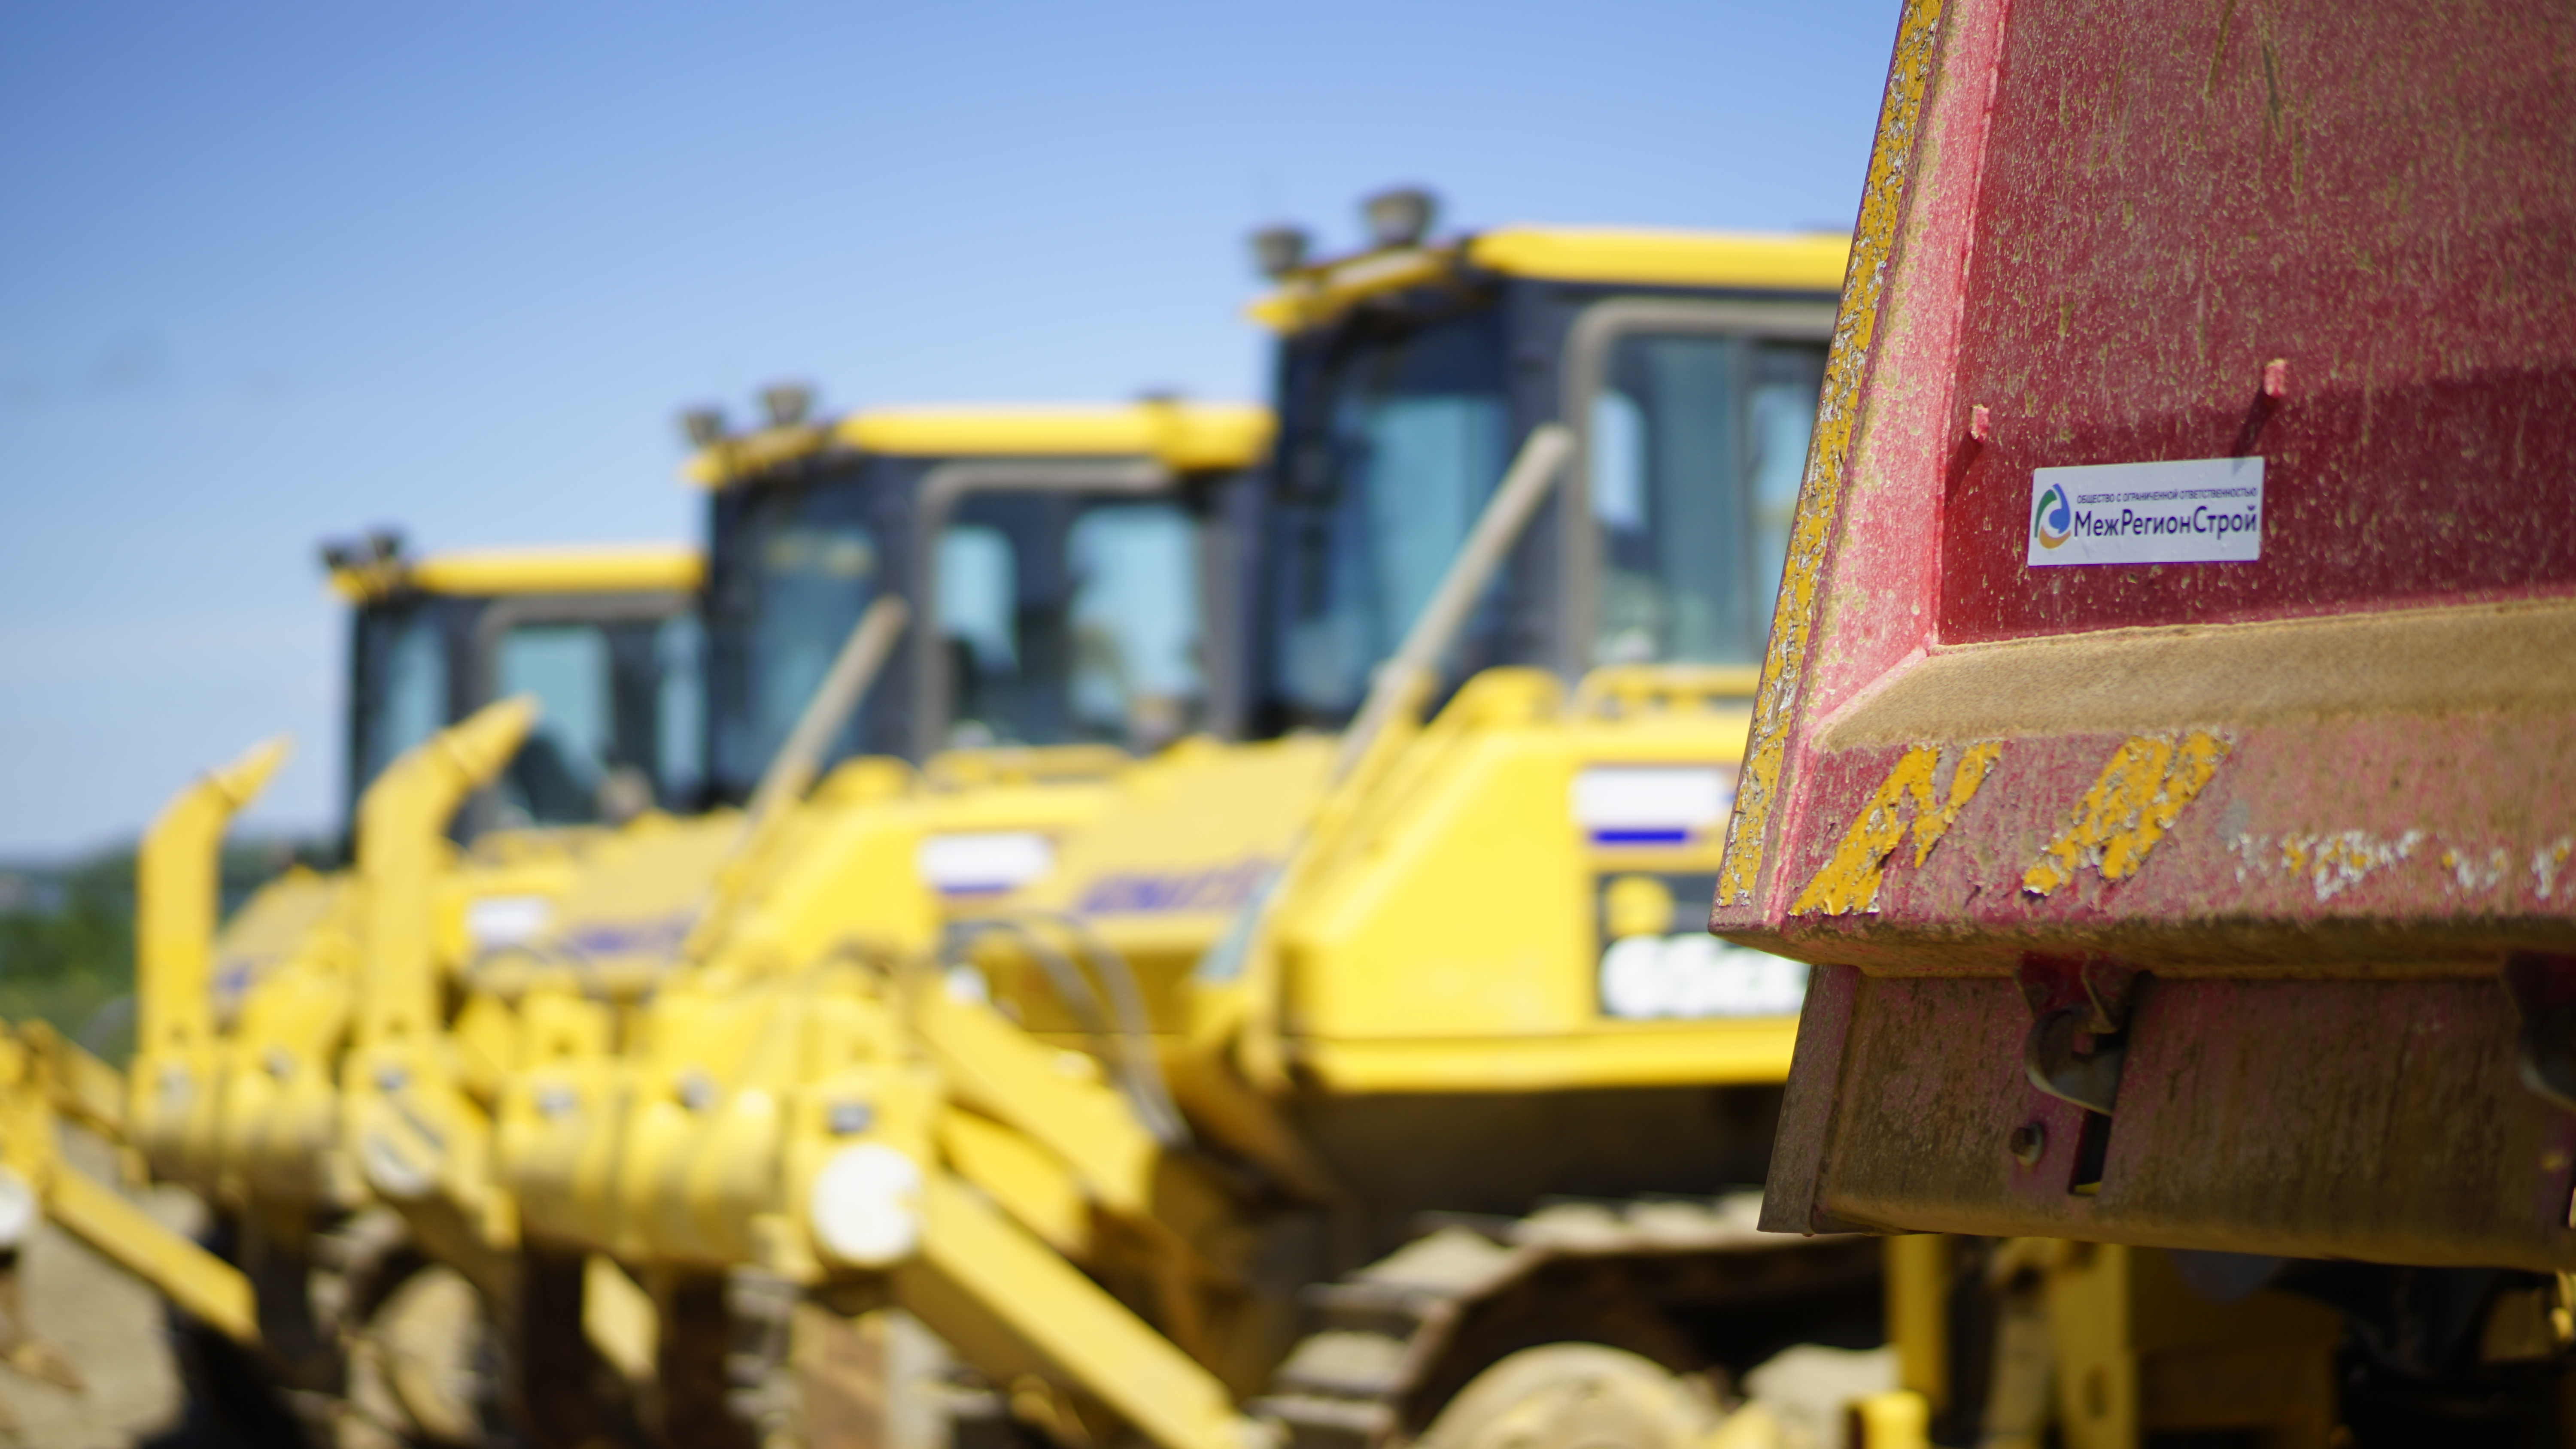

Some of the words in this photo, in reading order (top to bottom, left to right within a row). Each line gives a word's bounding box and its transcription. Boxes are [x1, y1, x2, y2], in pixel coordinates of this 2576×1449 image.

[2077, 494, 2114, 504] ОБЩЕСТВО
[2116, 494, 2121, 502] С
[2123, 489, 2178, 501] ОГРАНИЧЕННОЙ
[2180, 488, 2257, 500] ОТВЕТСТВЕННОСТЬЮ
[2074, 506, 2257, 540] МежРегионСтрой
